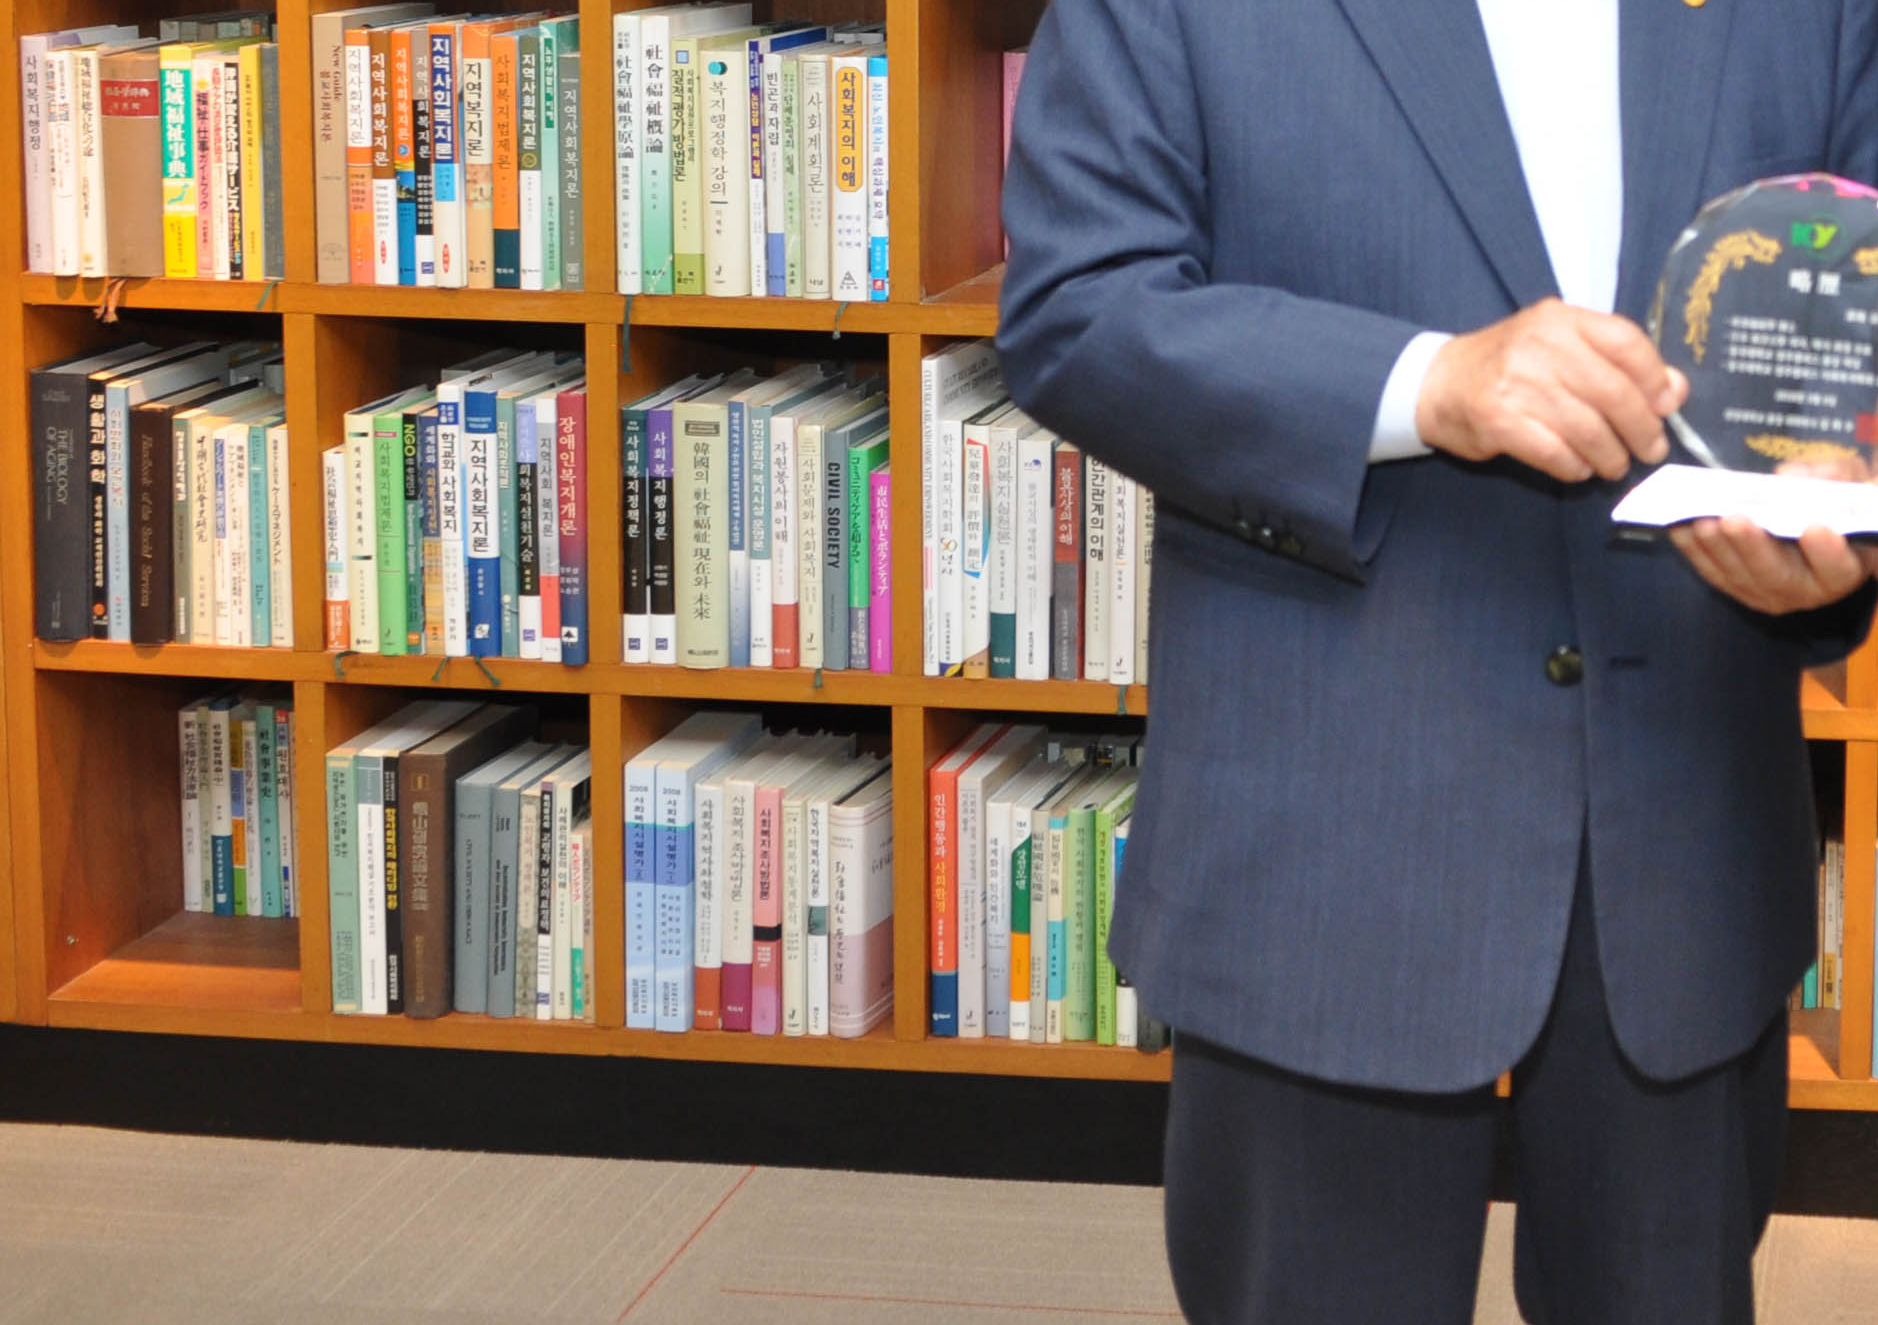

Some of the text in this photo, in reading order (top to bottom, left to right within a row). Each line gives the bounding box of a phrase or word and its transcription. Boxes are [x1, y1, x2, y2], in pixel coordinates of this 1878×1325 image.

[26, 55, 41, 151] 사회복지행정
[165, 70, 187, 178] 地域福祉事典
[371, 53, 390, 167] 지역사회복지론
[395, 48, 411, 141] 지역사회복지론
[416, 57, 431, 159] 지역사회복지론
[432, 38, 453, 161] 지역사회복지론
[465, 62, 484, 157] 지역복지론
[521, 53, 537, 150] 지역사회복지론
[563, 89, 580, 199] 지역사회복지론
[709, 81, 728, 197] 복지행정학 강의
[841, 72, 856, 187] 사회복지의 이해
[403, 424, 416, 457] NGO
[559, 416, 578, 536] 장애인복지개론
[653, 431, 668, 541] 사회복지행정론
[442, 476, 457, 533] 사회복지
[471, 439, 490, 553] 지역사회복지론
[692, 488, 711, 544] 社會福祉
[826, 462, 841, 569] CIVIL SOCIETY
